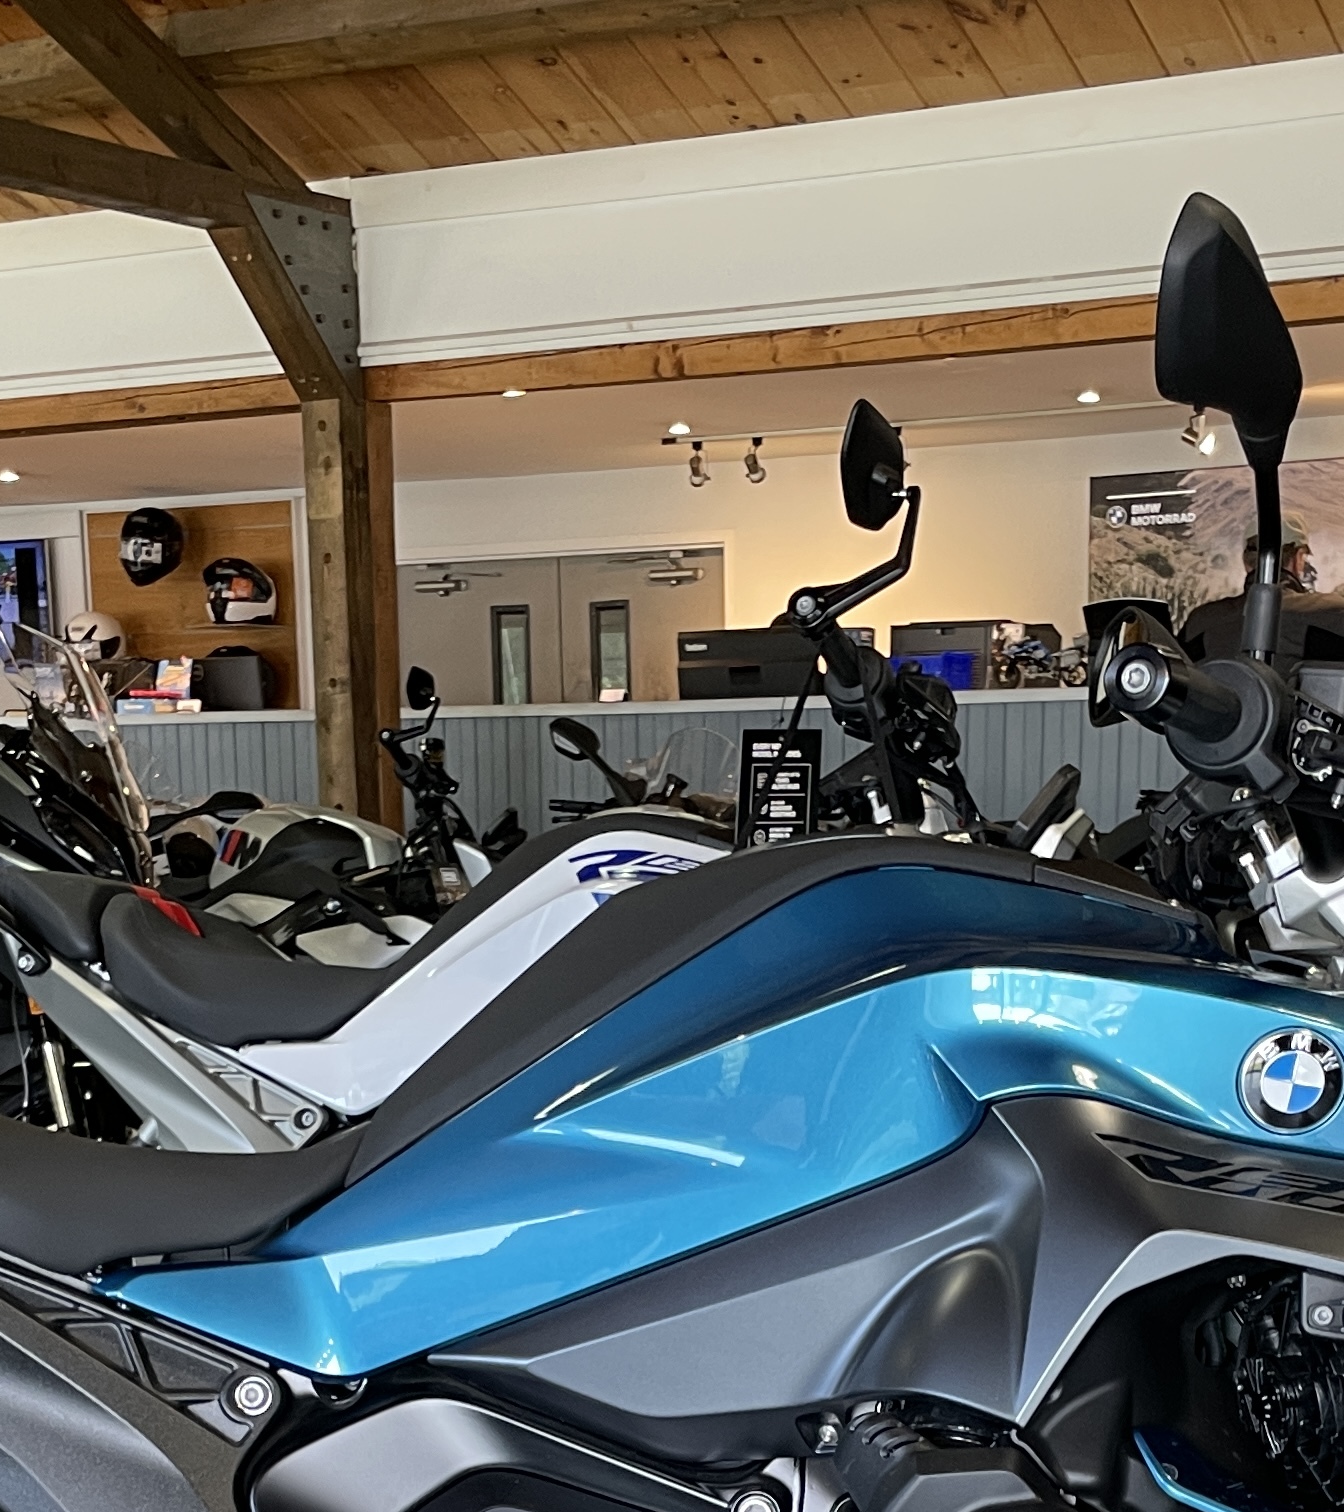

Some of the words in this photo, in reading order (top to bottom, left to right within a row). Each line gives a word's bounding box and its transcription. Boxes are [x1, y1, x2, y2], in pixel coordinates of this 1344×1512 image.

[1130, 502, 1162, 515] BMW
[1130, 512, 1197, 526] MOTORRAD
[1258, 1029, 1341, 1072] BMW
